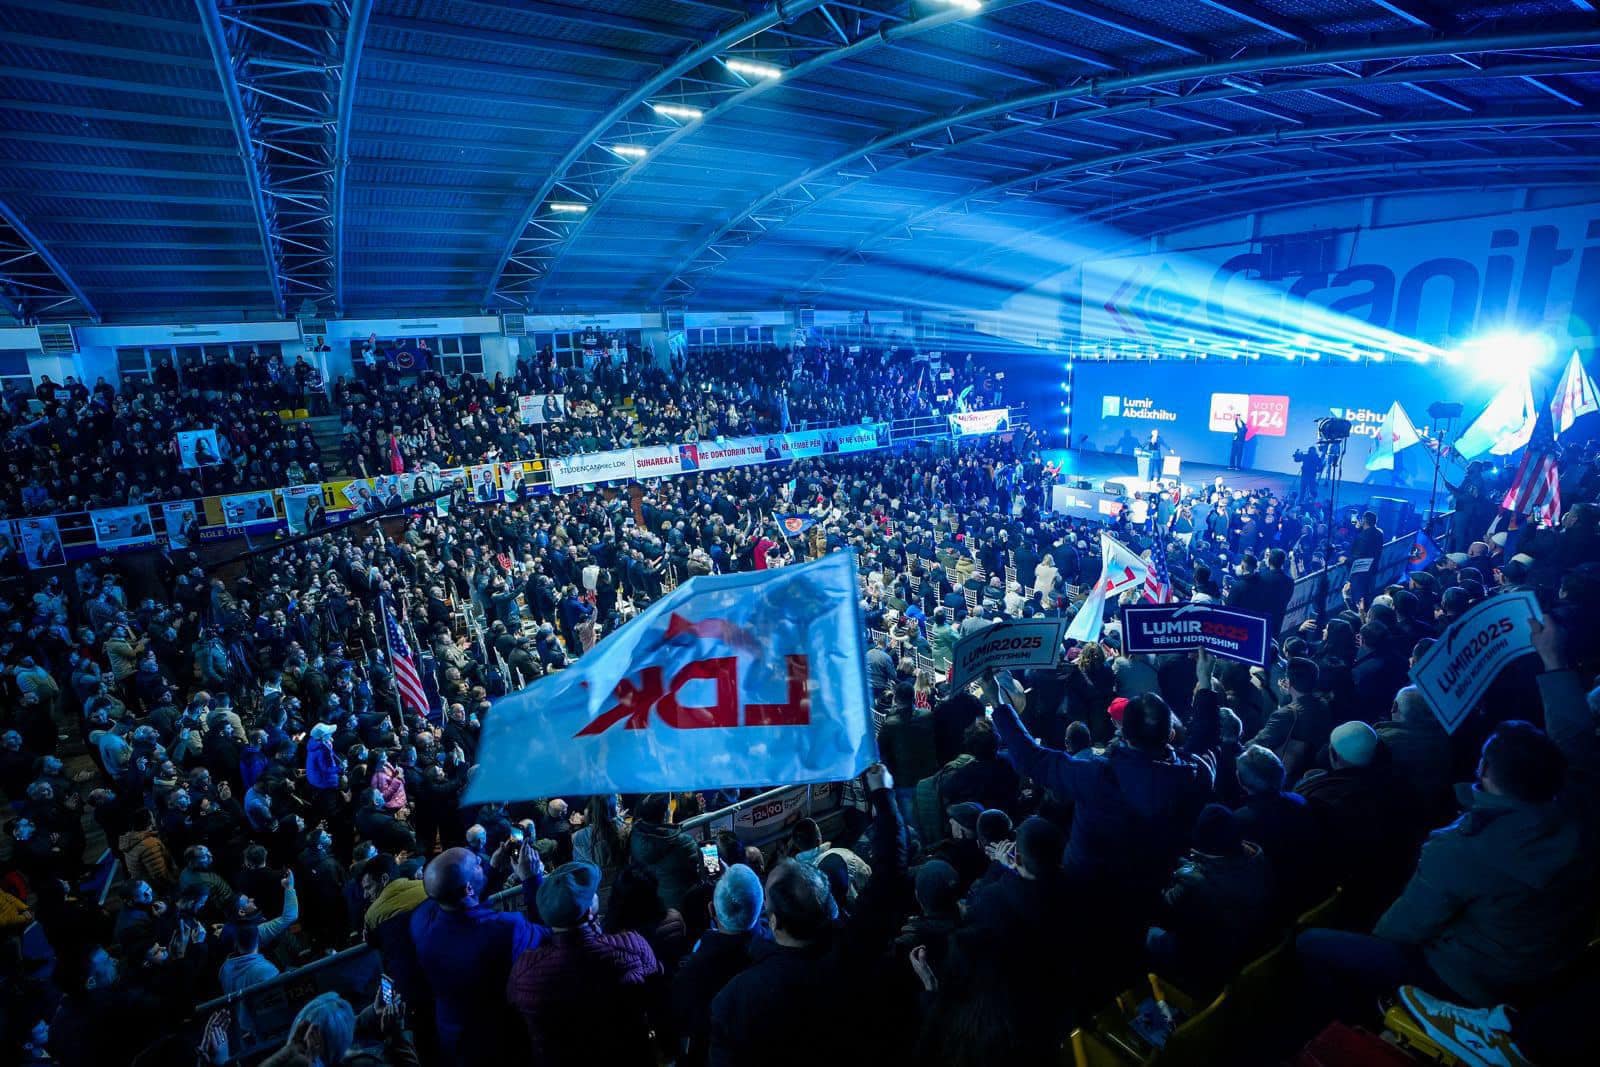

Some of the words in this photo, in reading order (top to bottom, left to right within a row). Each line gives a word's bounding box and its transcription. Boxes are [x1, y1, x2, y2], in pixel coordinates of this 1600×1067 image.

[1123, 397, 1153, 408] Lumir
[1253, 401, 1284, 411] VOTO
[1122, 408, 1177, 421] Abdixhiku
[1250, 410, 1284, 429] 124
[1345, 408, 1387, 422] bëhu
[636, 456, 674, 468] SUHAREKA
[675, 455, 680, 464] E
[699, 451, 710, 461] ME
[1142, 620, 1248, 641] LUMIR2025
[1183, 635, 1239, 650] NDRYSHIMI
[963, 636, 1043, 668] LUMIR2025
[1437, 617, 1514, 694] LUMIR2025
